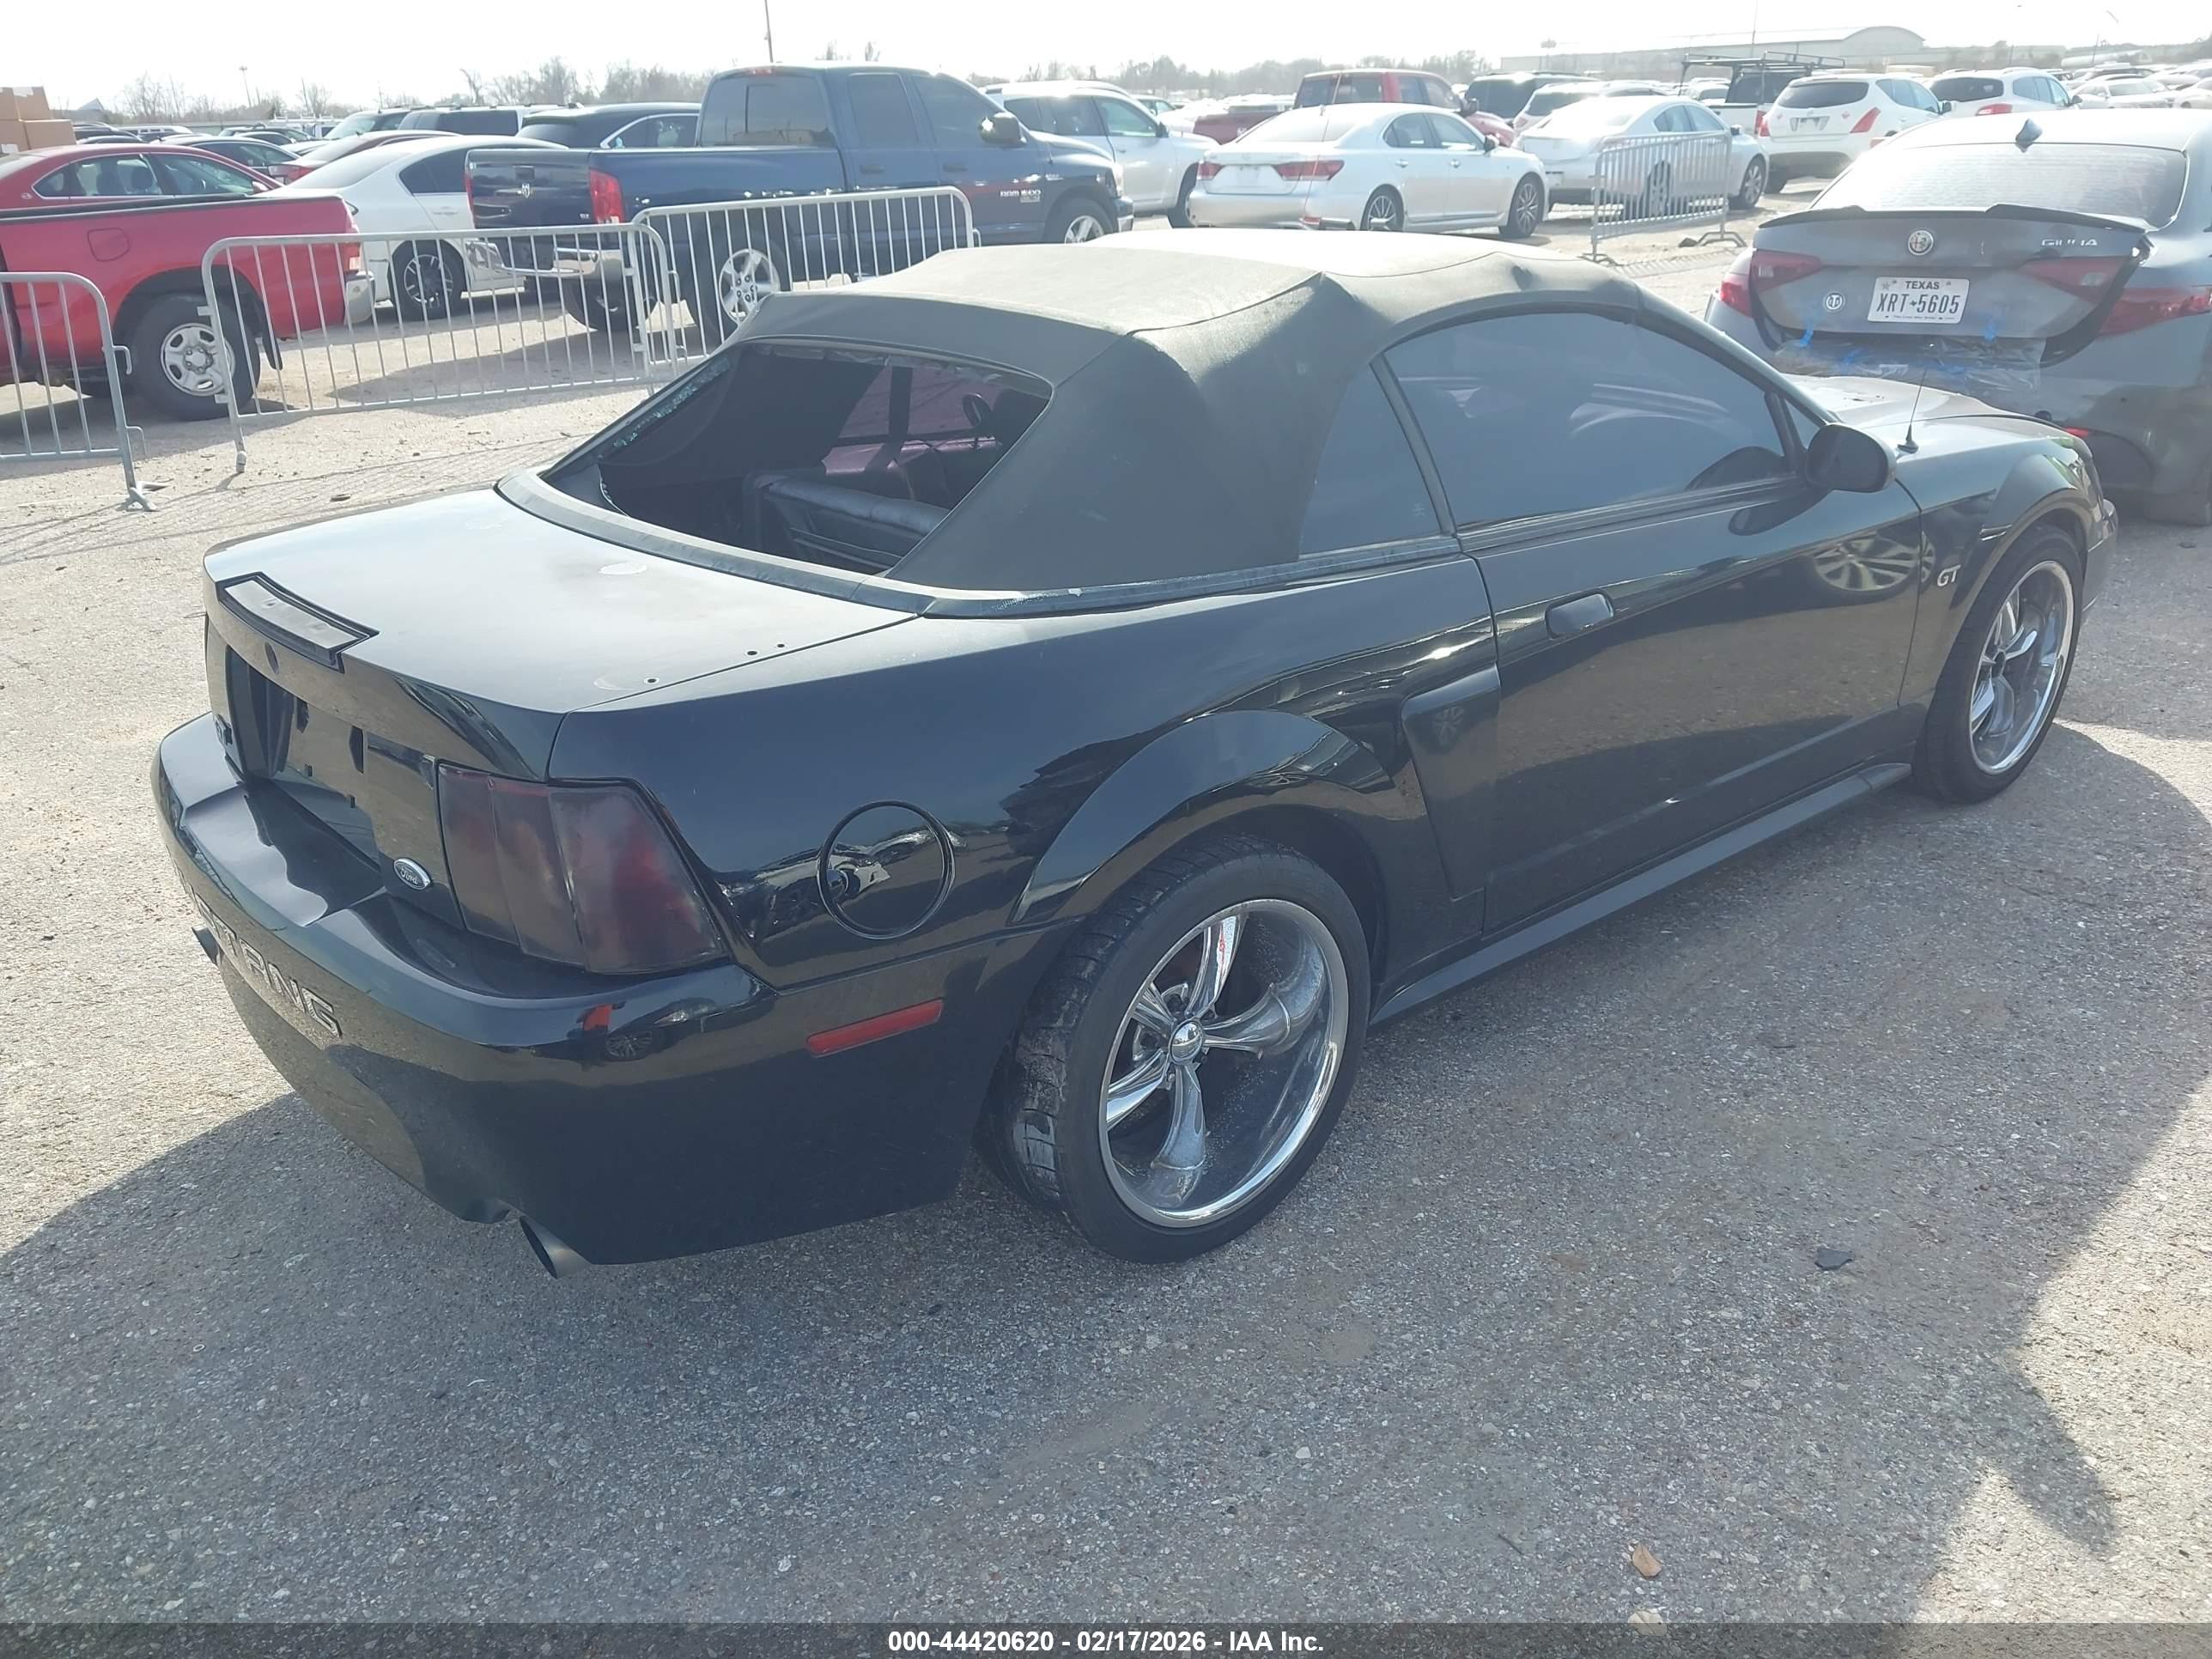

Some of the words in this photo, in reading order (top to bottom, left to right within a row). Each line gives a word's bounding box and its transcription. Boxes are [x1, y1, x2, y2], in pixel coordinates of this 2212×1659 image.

[1905, 281, 1940, 289] TEXAS
[1937, 564, 1961, 586] GT
[400, 865, 421, 885] Ford
